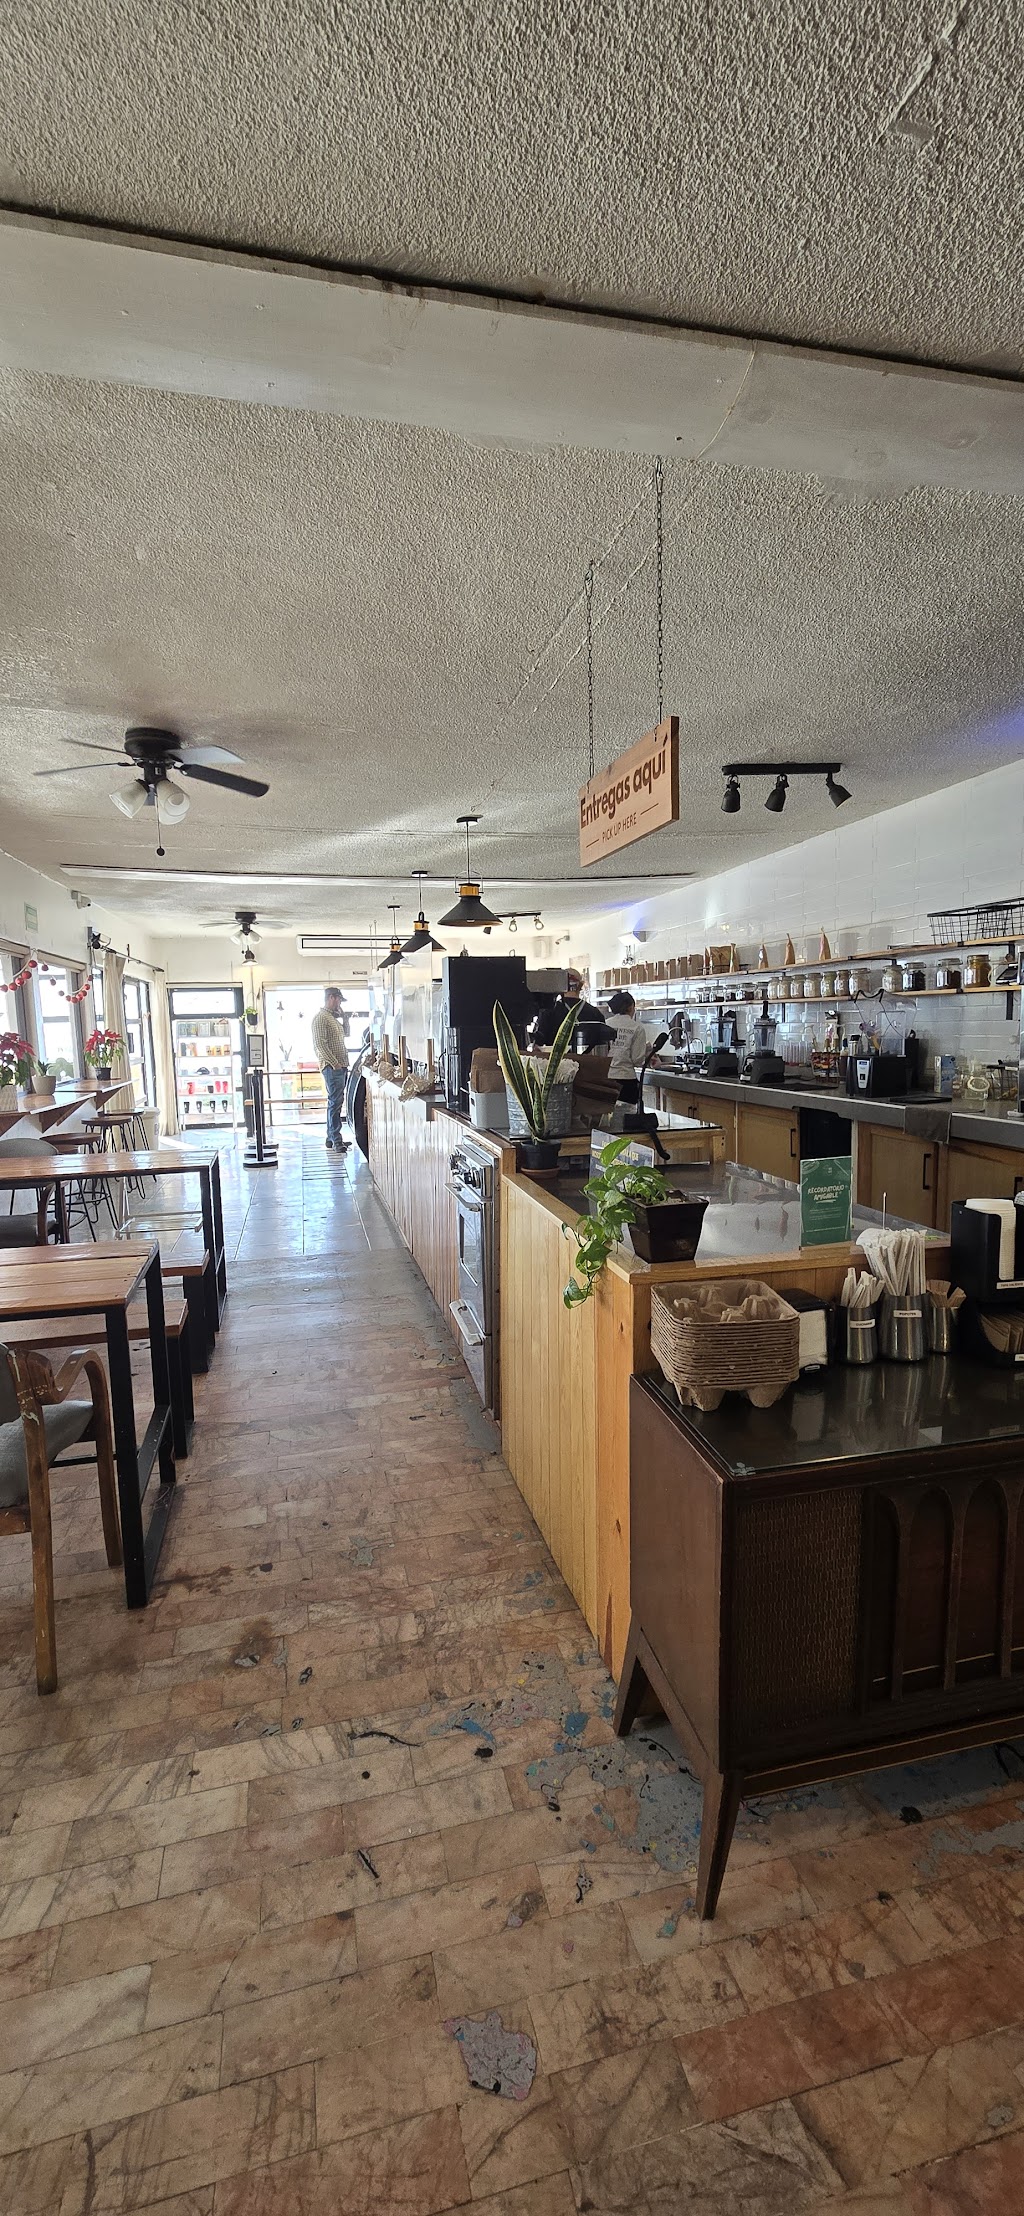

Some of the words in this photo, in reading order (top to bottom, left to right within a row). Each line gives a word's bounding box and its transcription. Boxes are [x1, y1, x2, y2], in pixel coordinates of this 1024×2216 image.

[580, 775, 630, 829] Entregas
[632, 733, 668, 794] aquí
[602, 825, 613, 842] PICK
[614, 822, 622, 836] UP
[622, 812, 637, 831] HERE
[808, 1184, 845, 1195] RECORDATORIO
[813, 1191, 839, 1201] AMIGABLE
